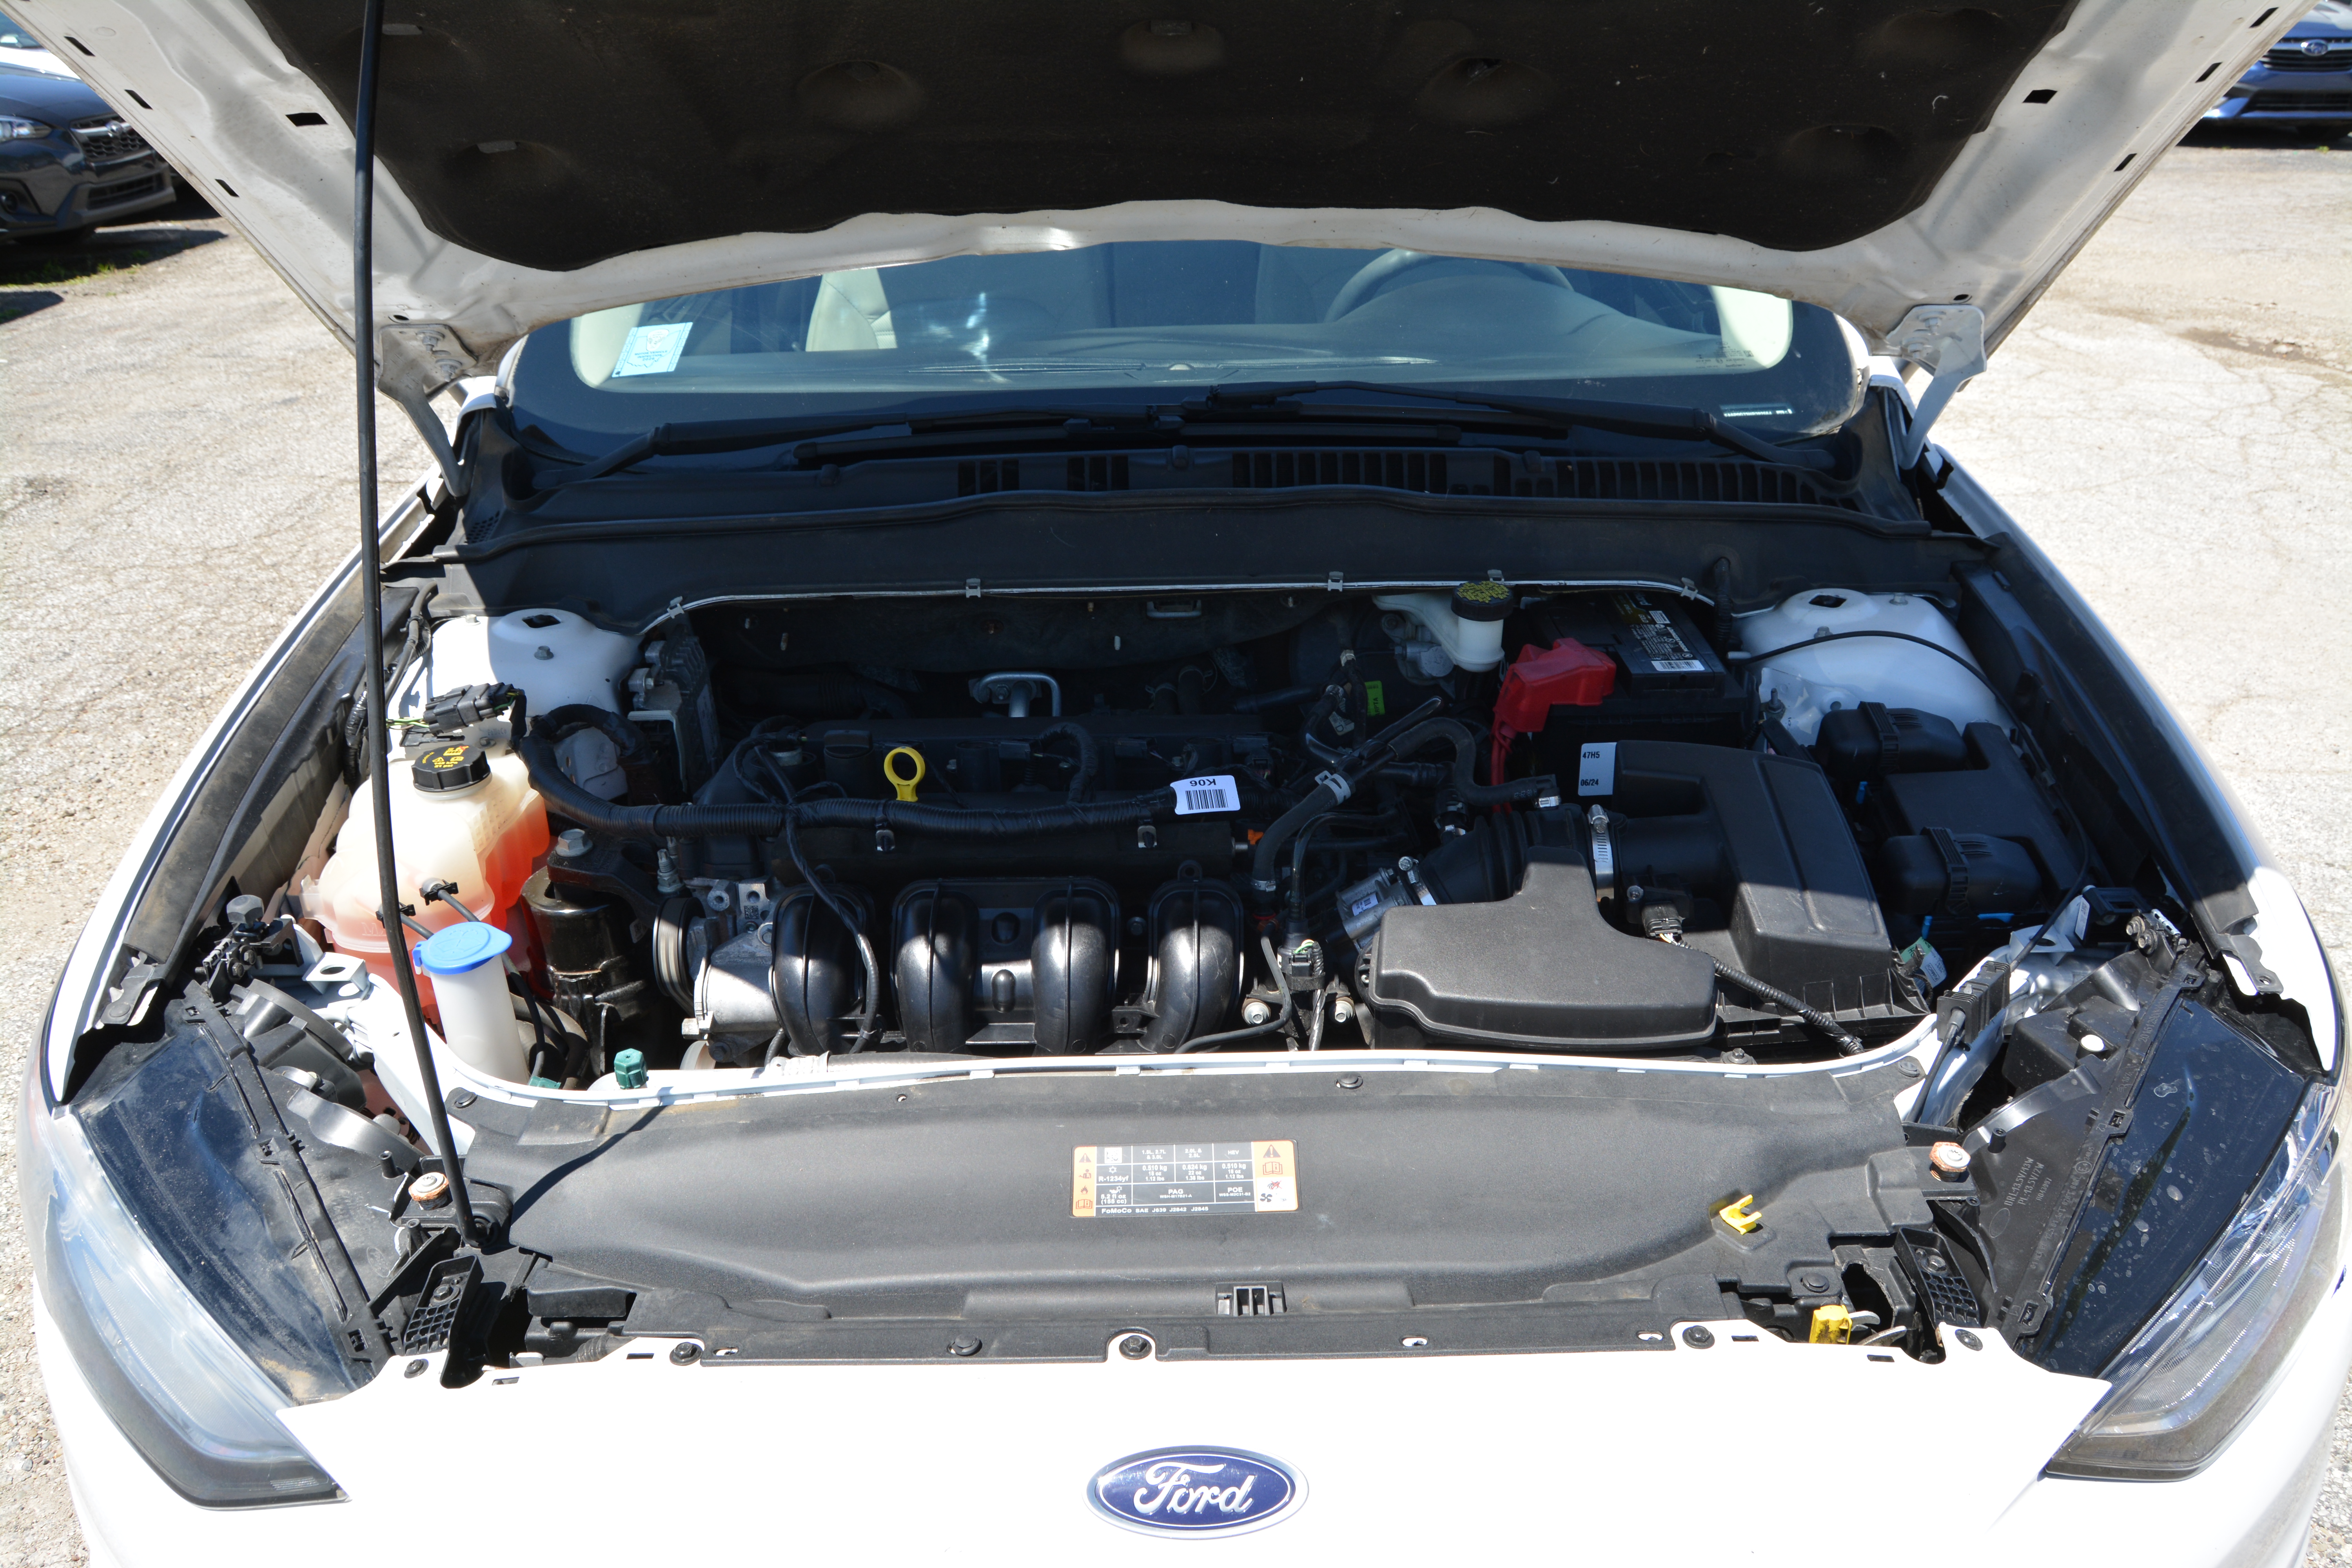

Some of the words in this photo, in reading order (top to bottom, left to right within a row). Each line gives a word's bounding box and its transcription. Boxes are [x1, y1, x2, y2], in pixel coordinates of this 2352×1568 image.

[1190, 779, 1216, 787] K06
[1927, 965, 1938, 980] FoMoCo
[1133, 1461, 1258, 1514] Ford
